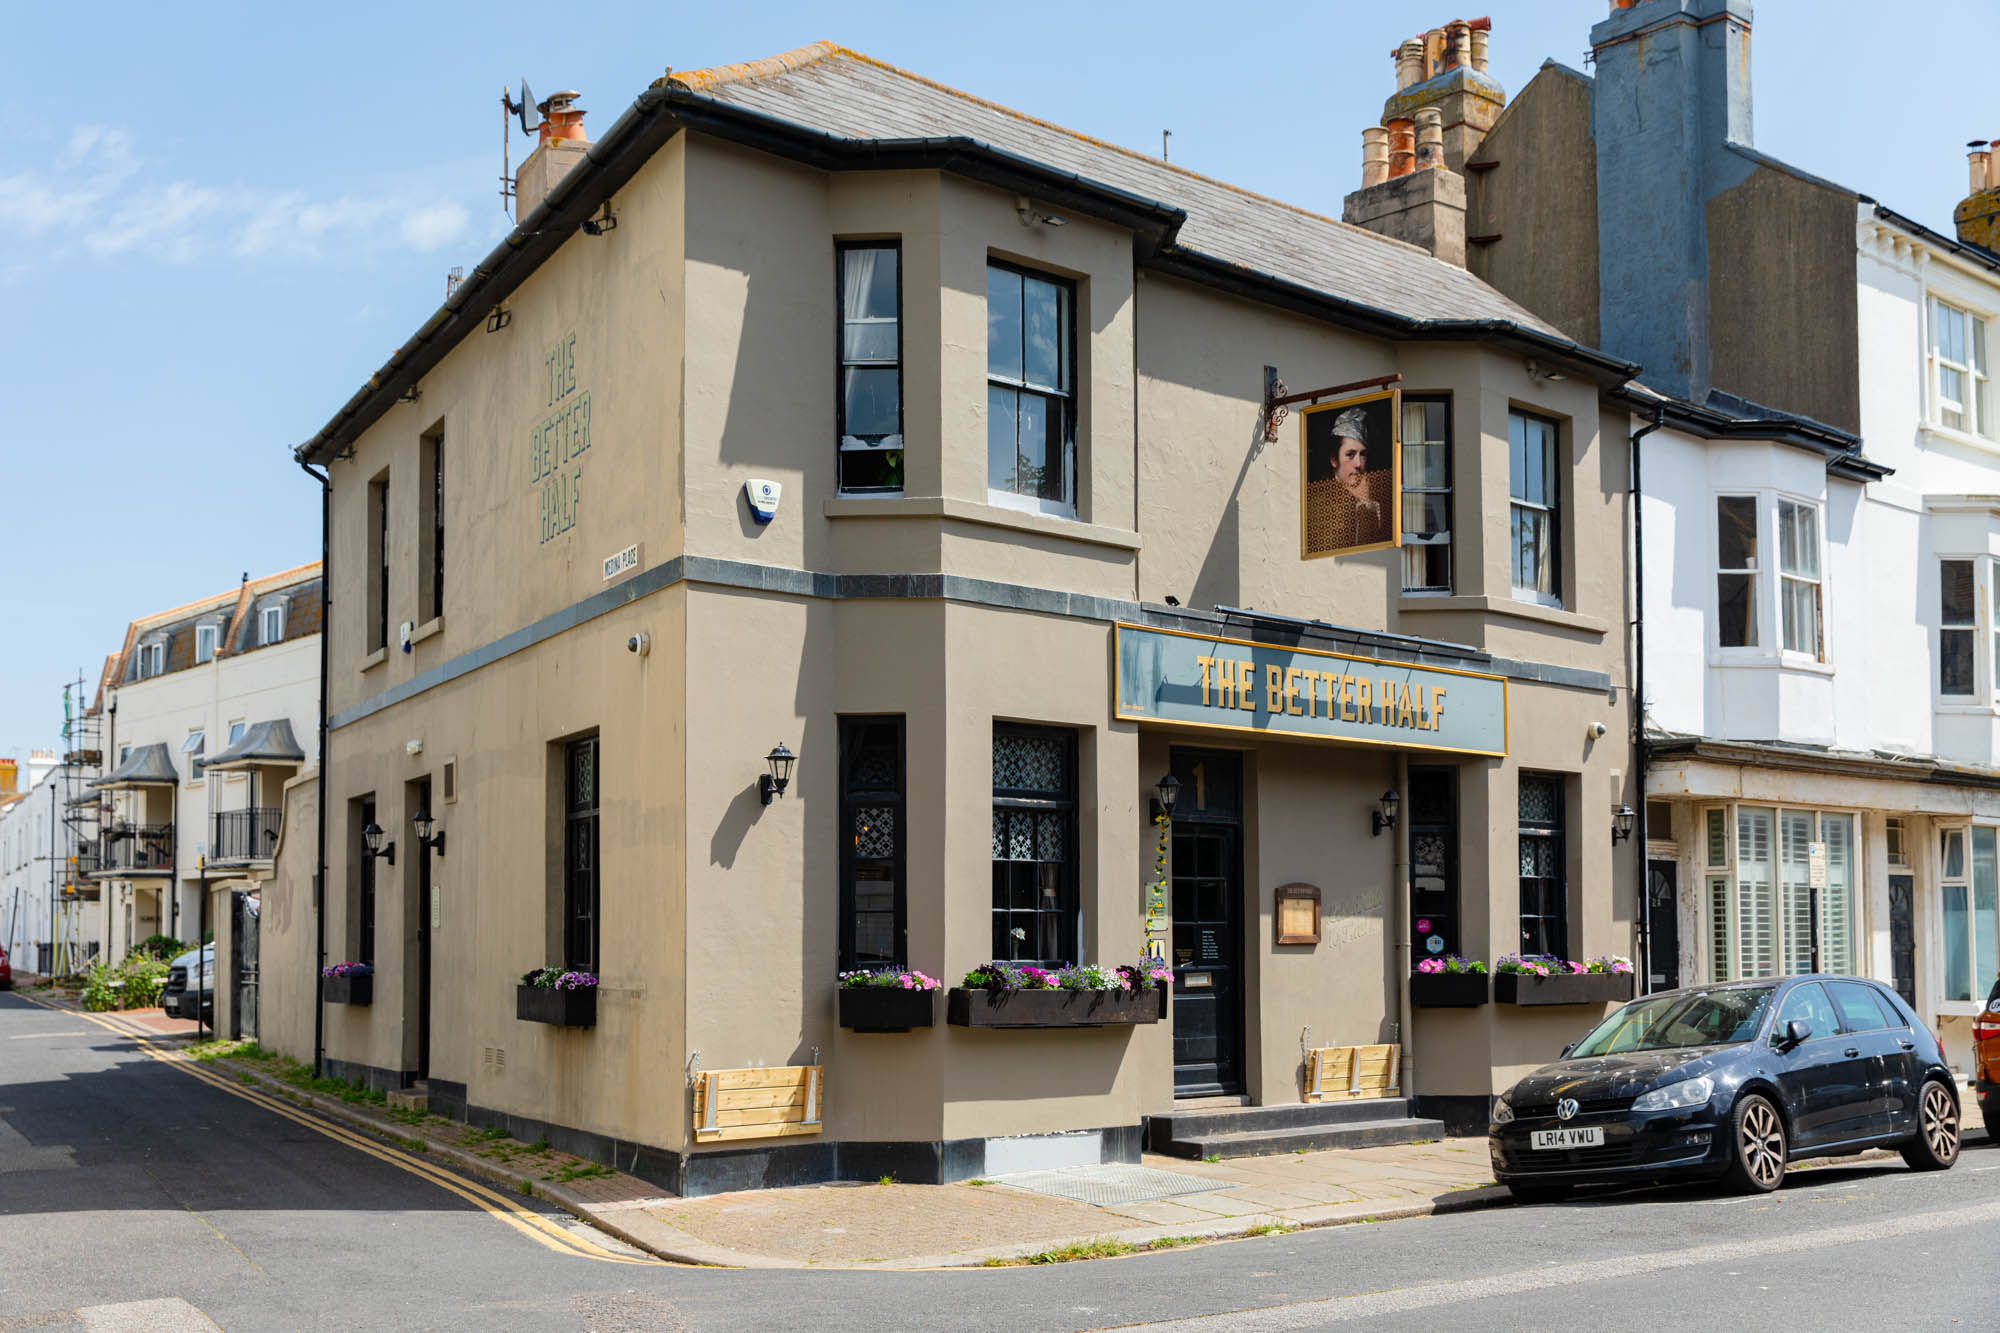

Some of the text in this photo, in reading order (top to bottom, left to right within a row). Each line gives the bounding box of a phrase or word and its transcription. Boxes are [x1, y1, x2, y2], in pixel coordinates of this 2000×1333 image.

[545, 332, 576, 407] THE
[531, 390, 591, 483] BETTER
[539, 467, 581, 544] HALF
[605, 547, 636, 577] MEDINA PLACE
[1197, 656, 1446, 731] THE BETTER HALF
[1192, 762, 1204, 810] 1
[1539, 1129, 1594, 1146] LR14 VWU
